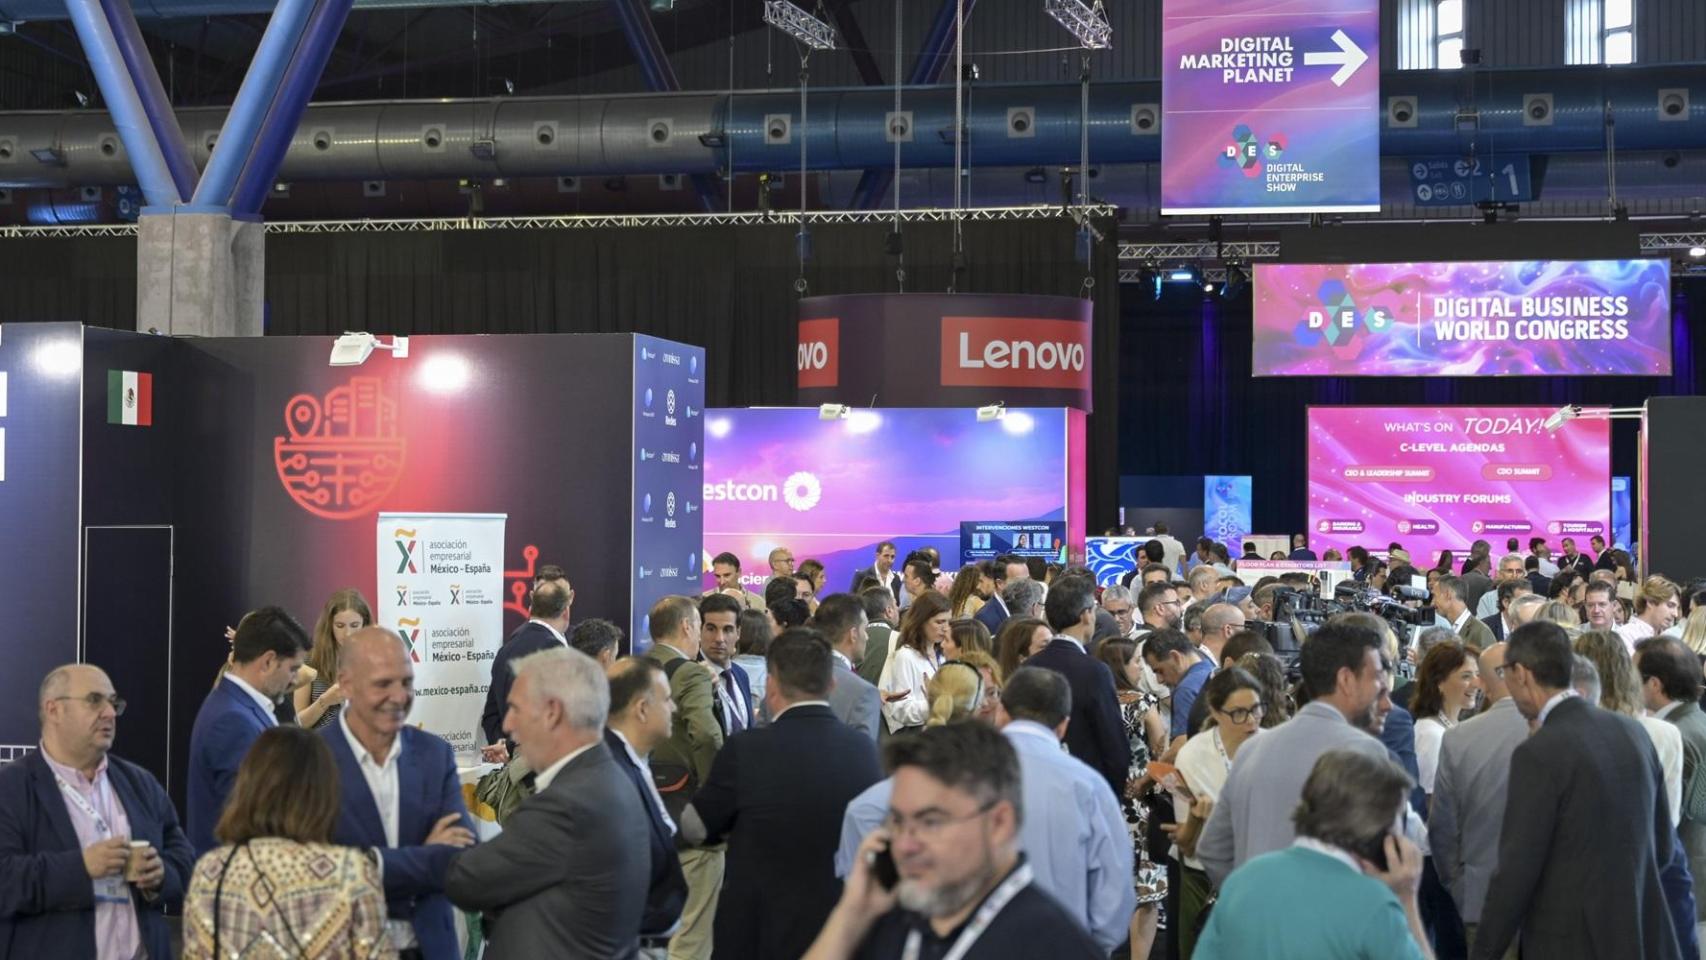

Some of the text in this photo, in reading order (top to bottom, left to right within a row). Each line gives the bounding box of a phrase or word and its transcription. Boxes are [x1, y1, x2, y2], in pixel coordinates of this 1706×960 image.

[1221, 37, 1294, 52] DIGITAL
[1180, 53, 1293, 69] MARKETING
[1223, 68, 1294, 83] PLANET
[1267, 164, 1304, 172] DIGITAL
[1267, 173, 1324, 182] ENTERPRISE
[1502, 164, 1519, 196] 1
[1267, 183, 1296, 192] SHOW
[1433, 296, 1629, 318] DIGITAL BUSINESS
[1434, 319, 1629, 341] WORLD CONGRESS
[959, 332, 1085, 372] Lenovo
[1384, 418, 1545, 435] WHAT'S ON TODAY!
[1400, 443, 1505, 452] C-LEVEL AGENDAS
[1513, 468, 1540, 476] SUMMIT
[1404, 493, 1512, 505] INDUSTRY FORUMS
[429, 539, 467, 549] asociación
[430, 550, 471, 561] empresarial
[430, 563, 459, 574] México
[465, 563, 491, 575] España
[432, 627, 470, 637] asociación
[432, 638, 474, 650] empresarial
[432, 651, 461, 662] México
[467, 650, 494, 662] España
